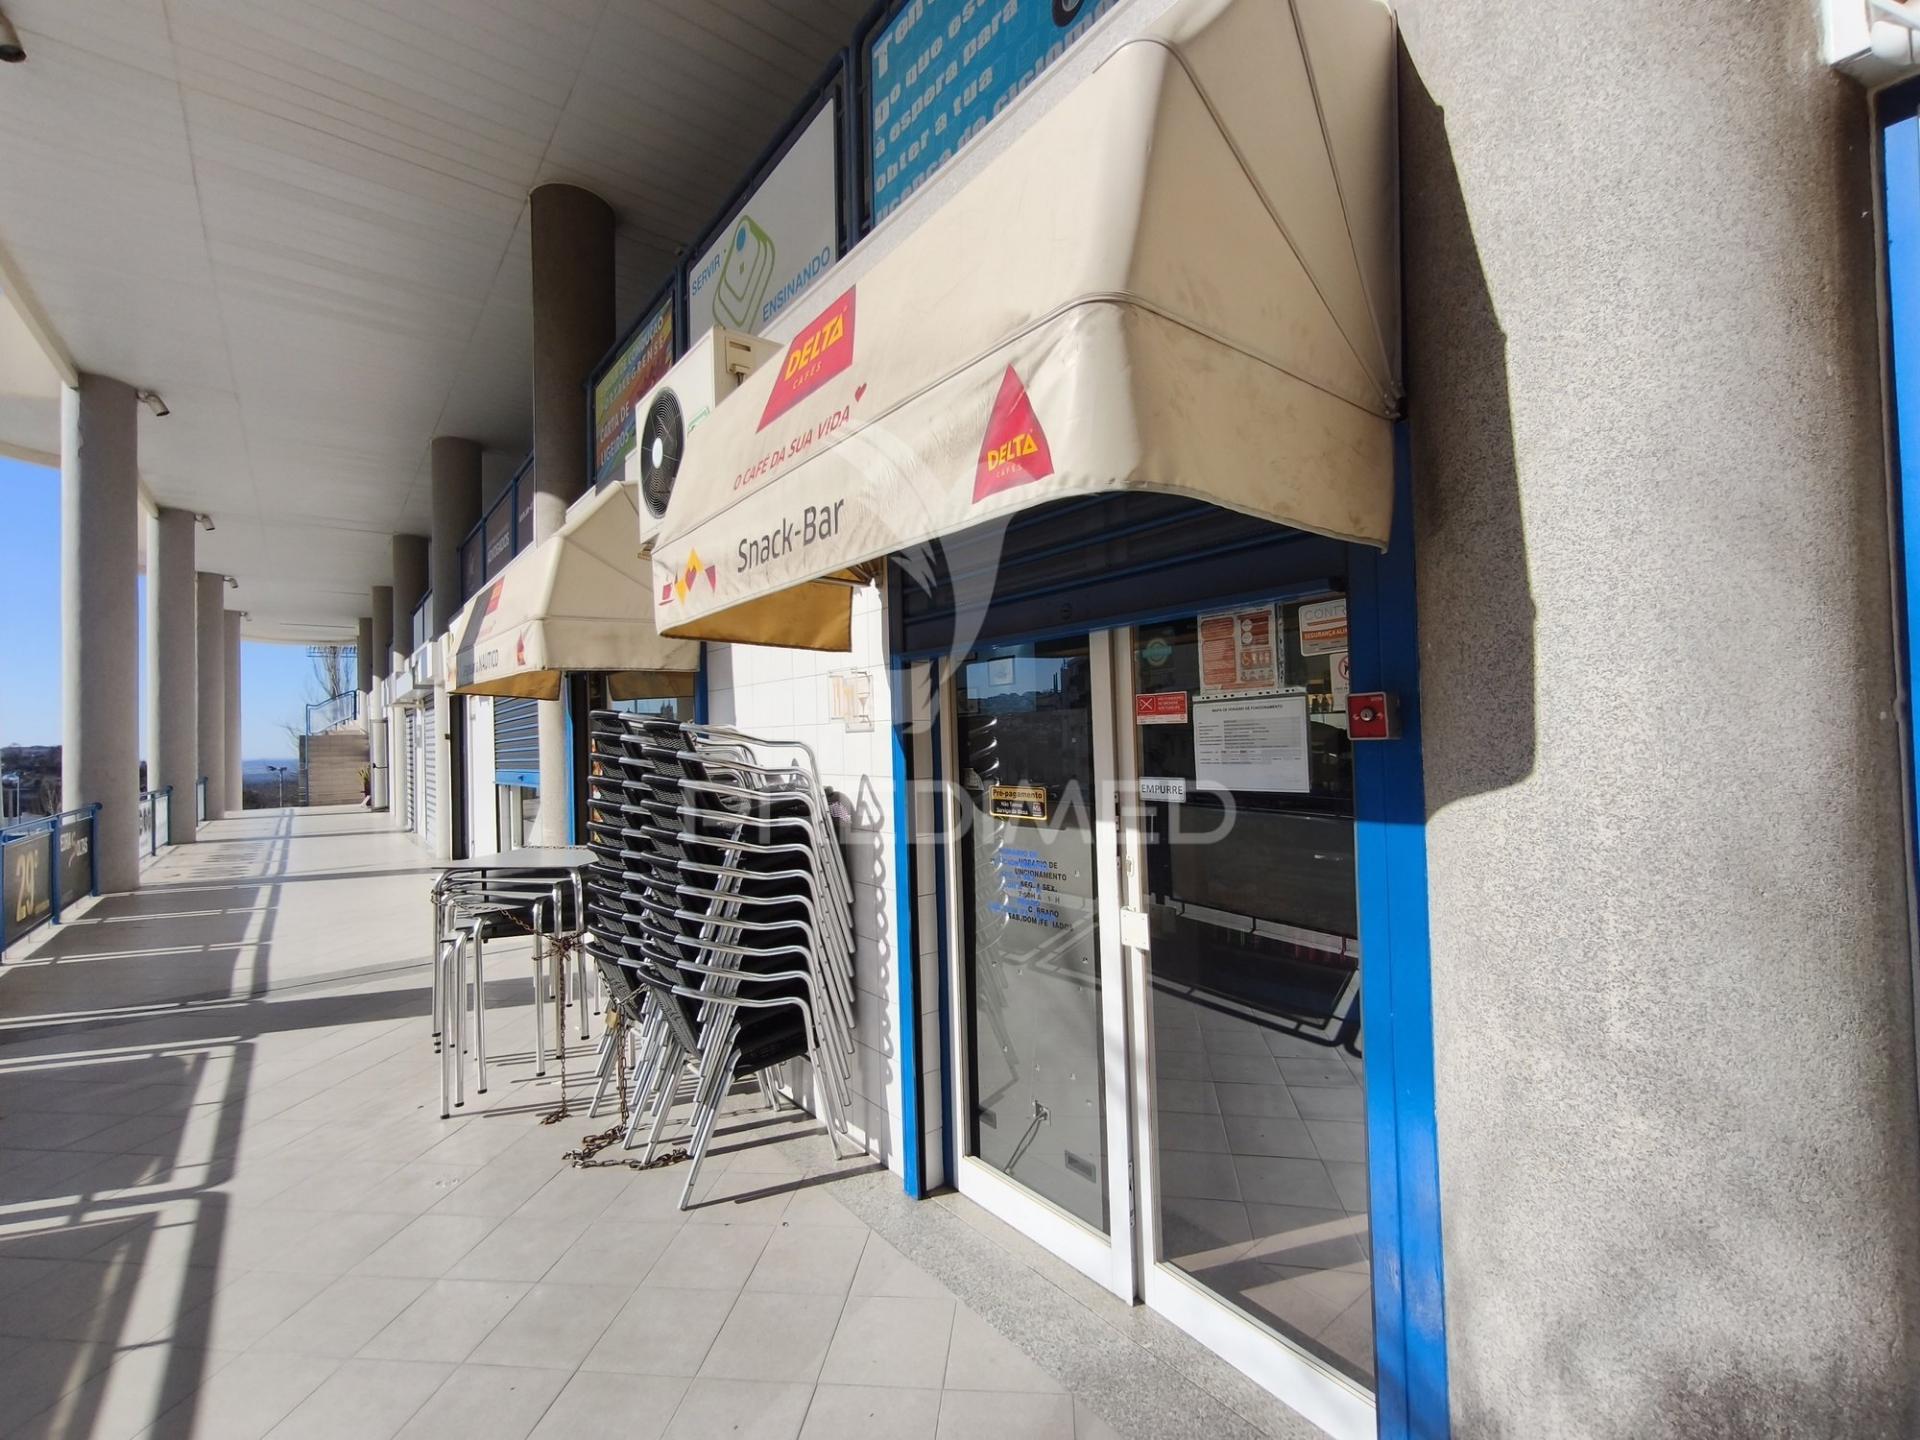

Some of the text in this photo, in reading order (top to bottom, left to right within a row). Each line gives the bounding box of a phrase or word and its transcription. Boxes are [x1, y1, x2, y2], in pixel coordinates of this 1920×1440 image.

[889, 60, 958, 143] espera
[963, 0, 1018, 68] para
[905, 35, 943, 88] que
[947, 0, 986, 40] es
[876, 66, 993, 193] obter a tua
[691, 253, 722, 296] SERVIR
[762, 245, 831, 323] ENSINANDO
[784, 313, 844, 381] DELTA
[770, 447, 786, 469] DA
[787, 428, 813, 458] SUA
[817, 404, 850, 440] VIDA
[986, 432, 1039, 472] DELTA
[737, 498, 845, 574] Snack-Bar
[1140, 783, 1184, 796] EMPURRE
[1048, 861, 1059, 870] DE
